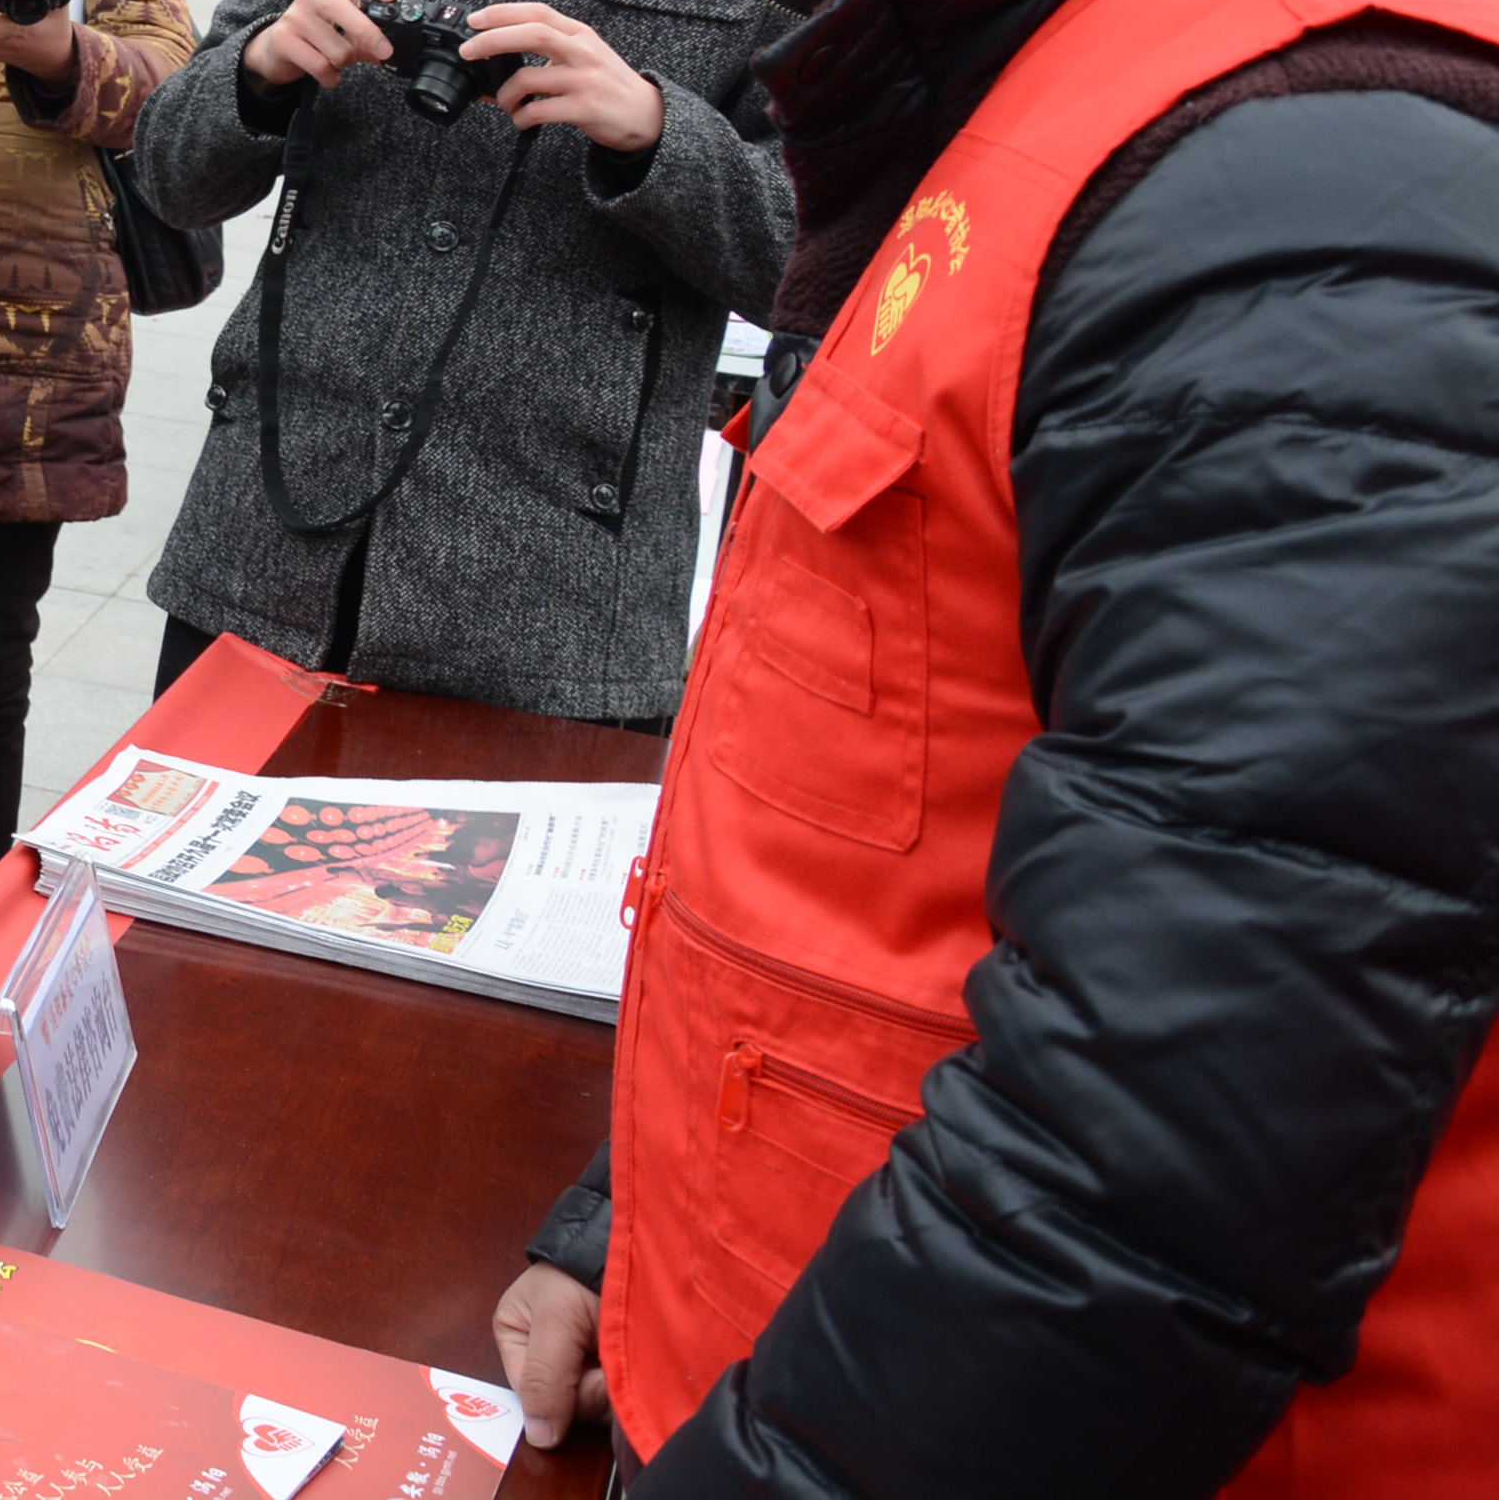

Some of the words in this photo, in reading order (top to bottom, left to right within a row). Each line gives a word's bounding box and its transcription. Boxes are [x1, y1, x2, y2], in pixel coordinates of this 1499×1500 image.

[271, 189, 299, 255] Canon
[96, 1444, 164, 1498] 人人受益
